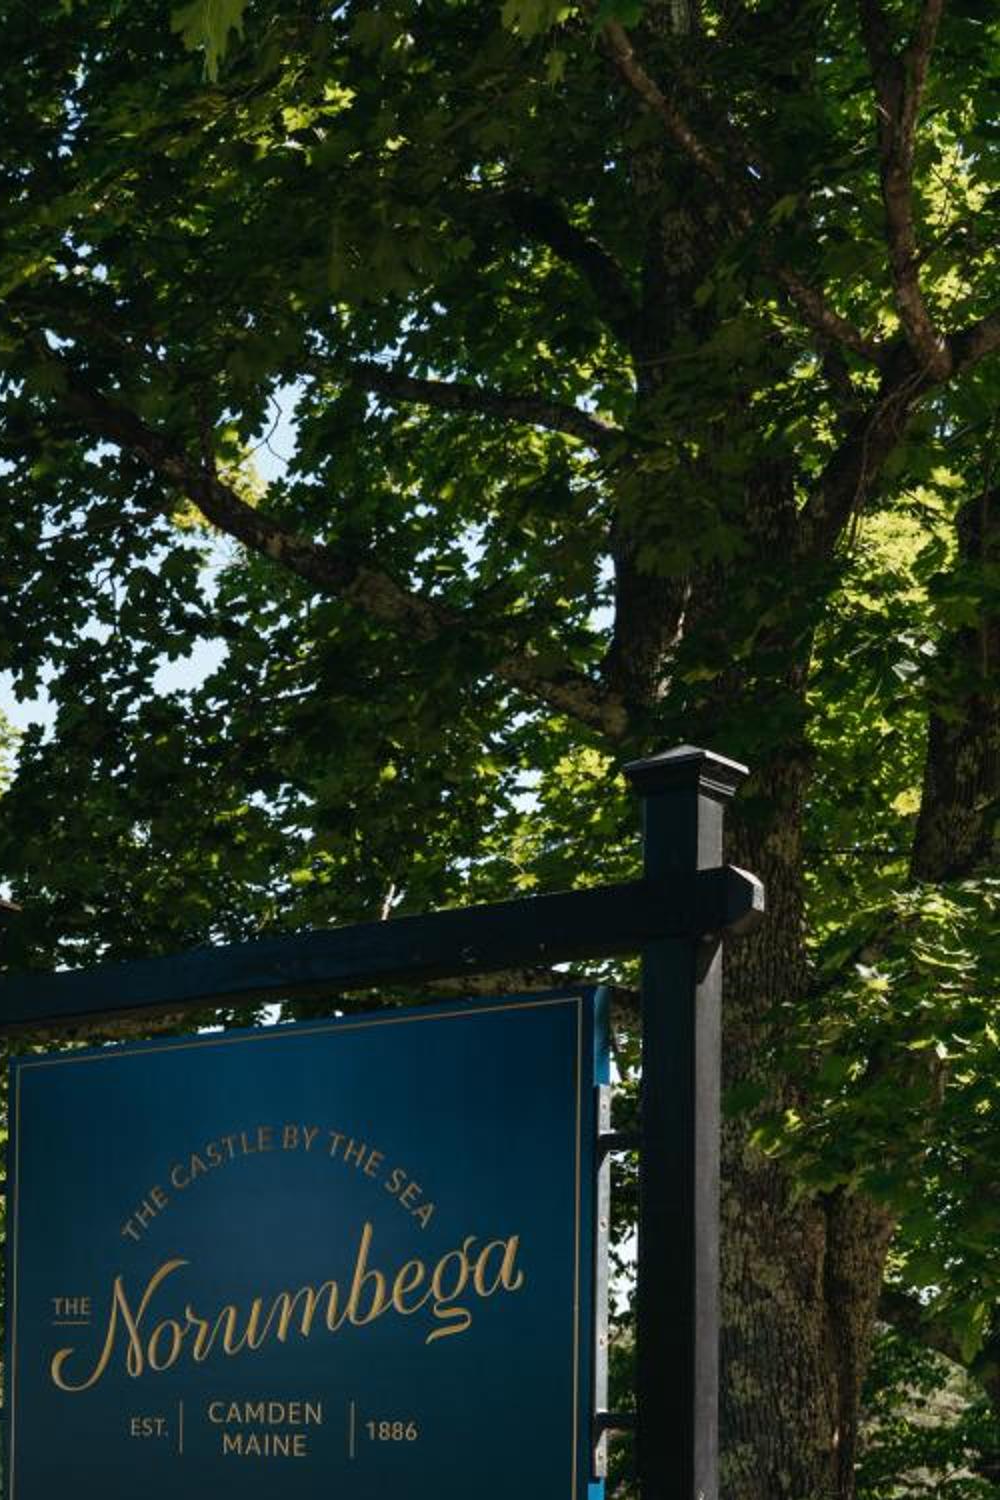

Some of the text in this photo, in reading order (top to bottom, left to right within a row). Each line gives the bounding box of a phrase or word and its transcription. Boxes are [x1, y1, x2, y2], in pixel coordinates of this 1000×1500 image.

[121, 1124, 437, 1242] THE CASTLE BY THE SEA
[50, 1222, 525, 1392] Norumbega
[52, 1297, 91, 1316] THE
[208, 1401, 322, 1425] CAMDEN
[130, 1417, 169, 1437] EST.
[366, 1420, 418, 1441] 1886
[223, 1434, 306, 1457] MAINE
